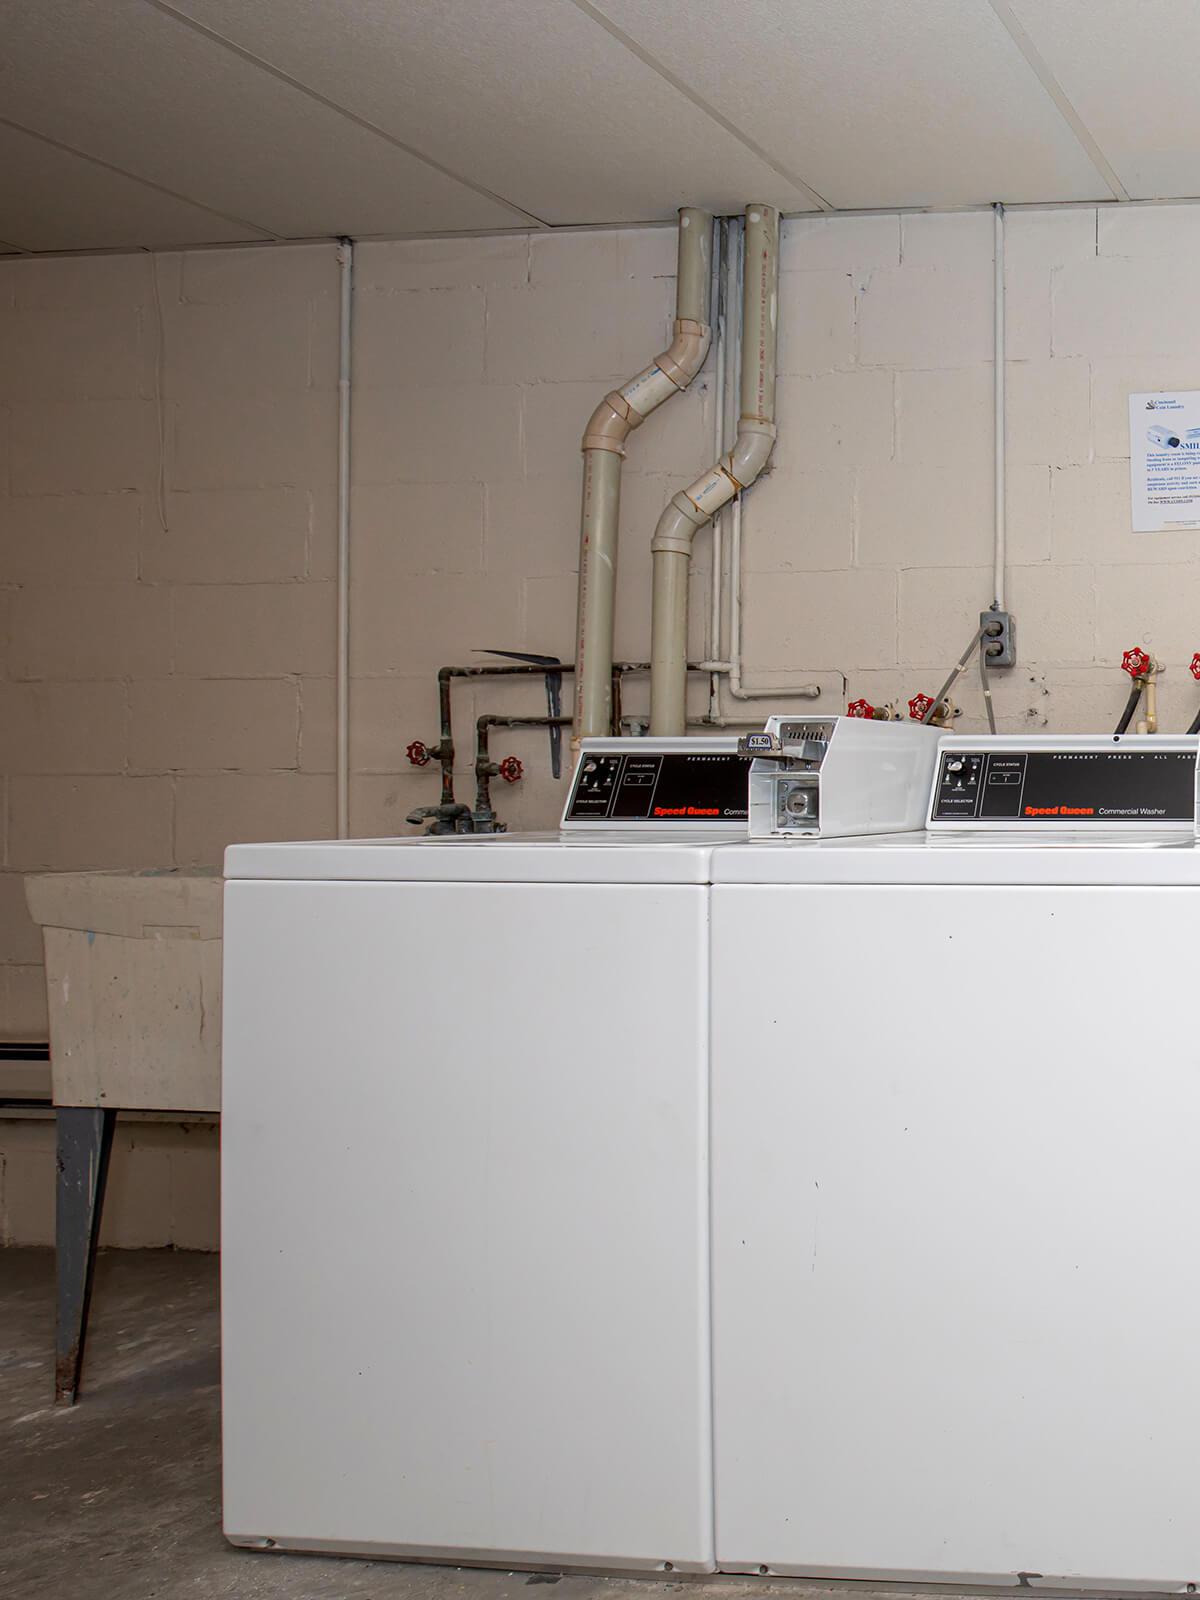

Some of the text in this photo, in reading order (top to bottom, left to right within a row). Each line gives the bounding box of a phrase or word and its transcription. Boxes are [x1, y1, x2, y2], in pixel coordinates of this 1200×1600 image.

[751, 737, 769, 745] $1.50
[654, 806, 686, 816] Speed
[688, 806, 719, 815] Queen
[1025, 806, 1058, 816] Speed
[1060, 806, 1093, 815] Queen
